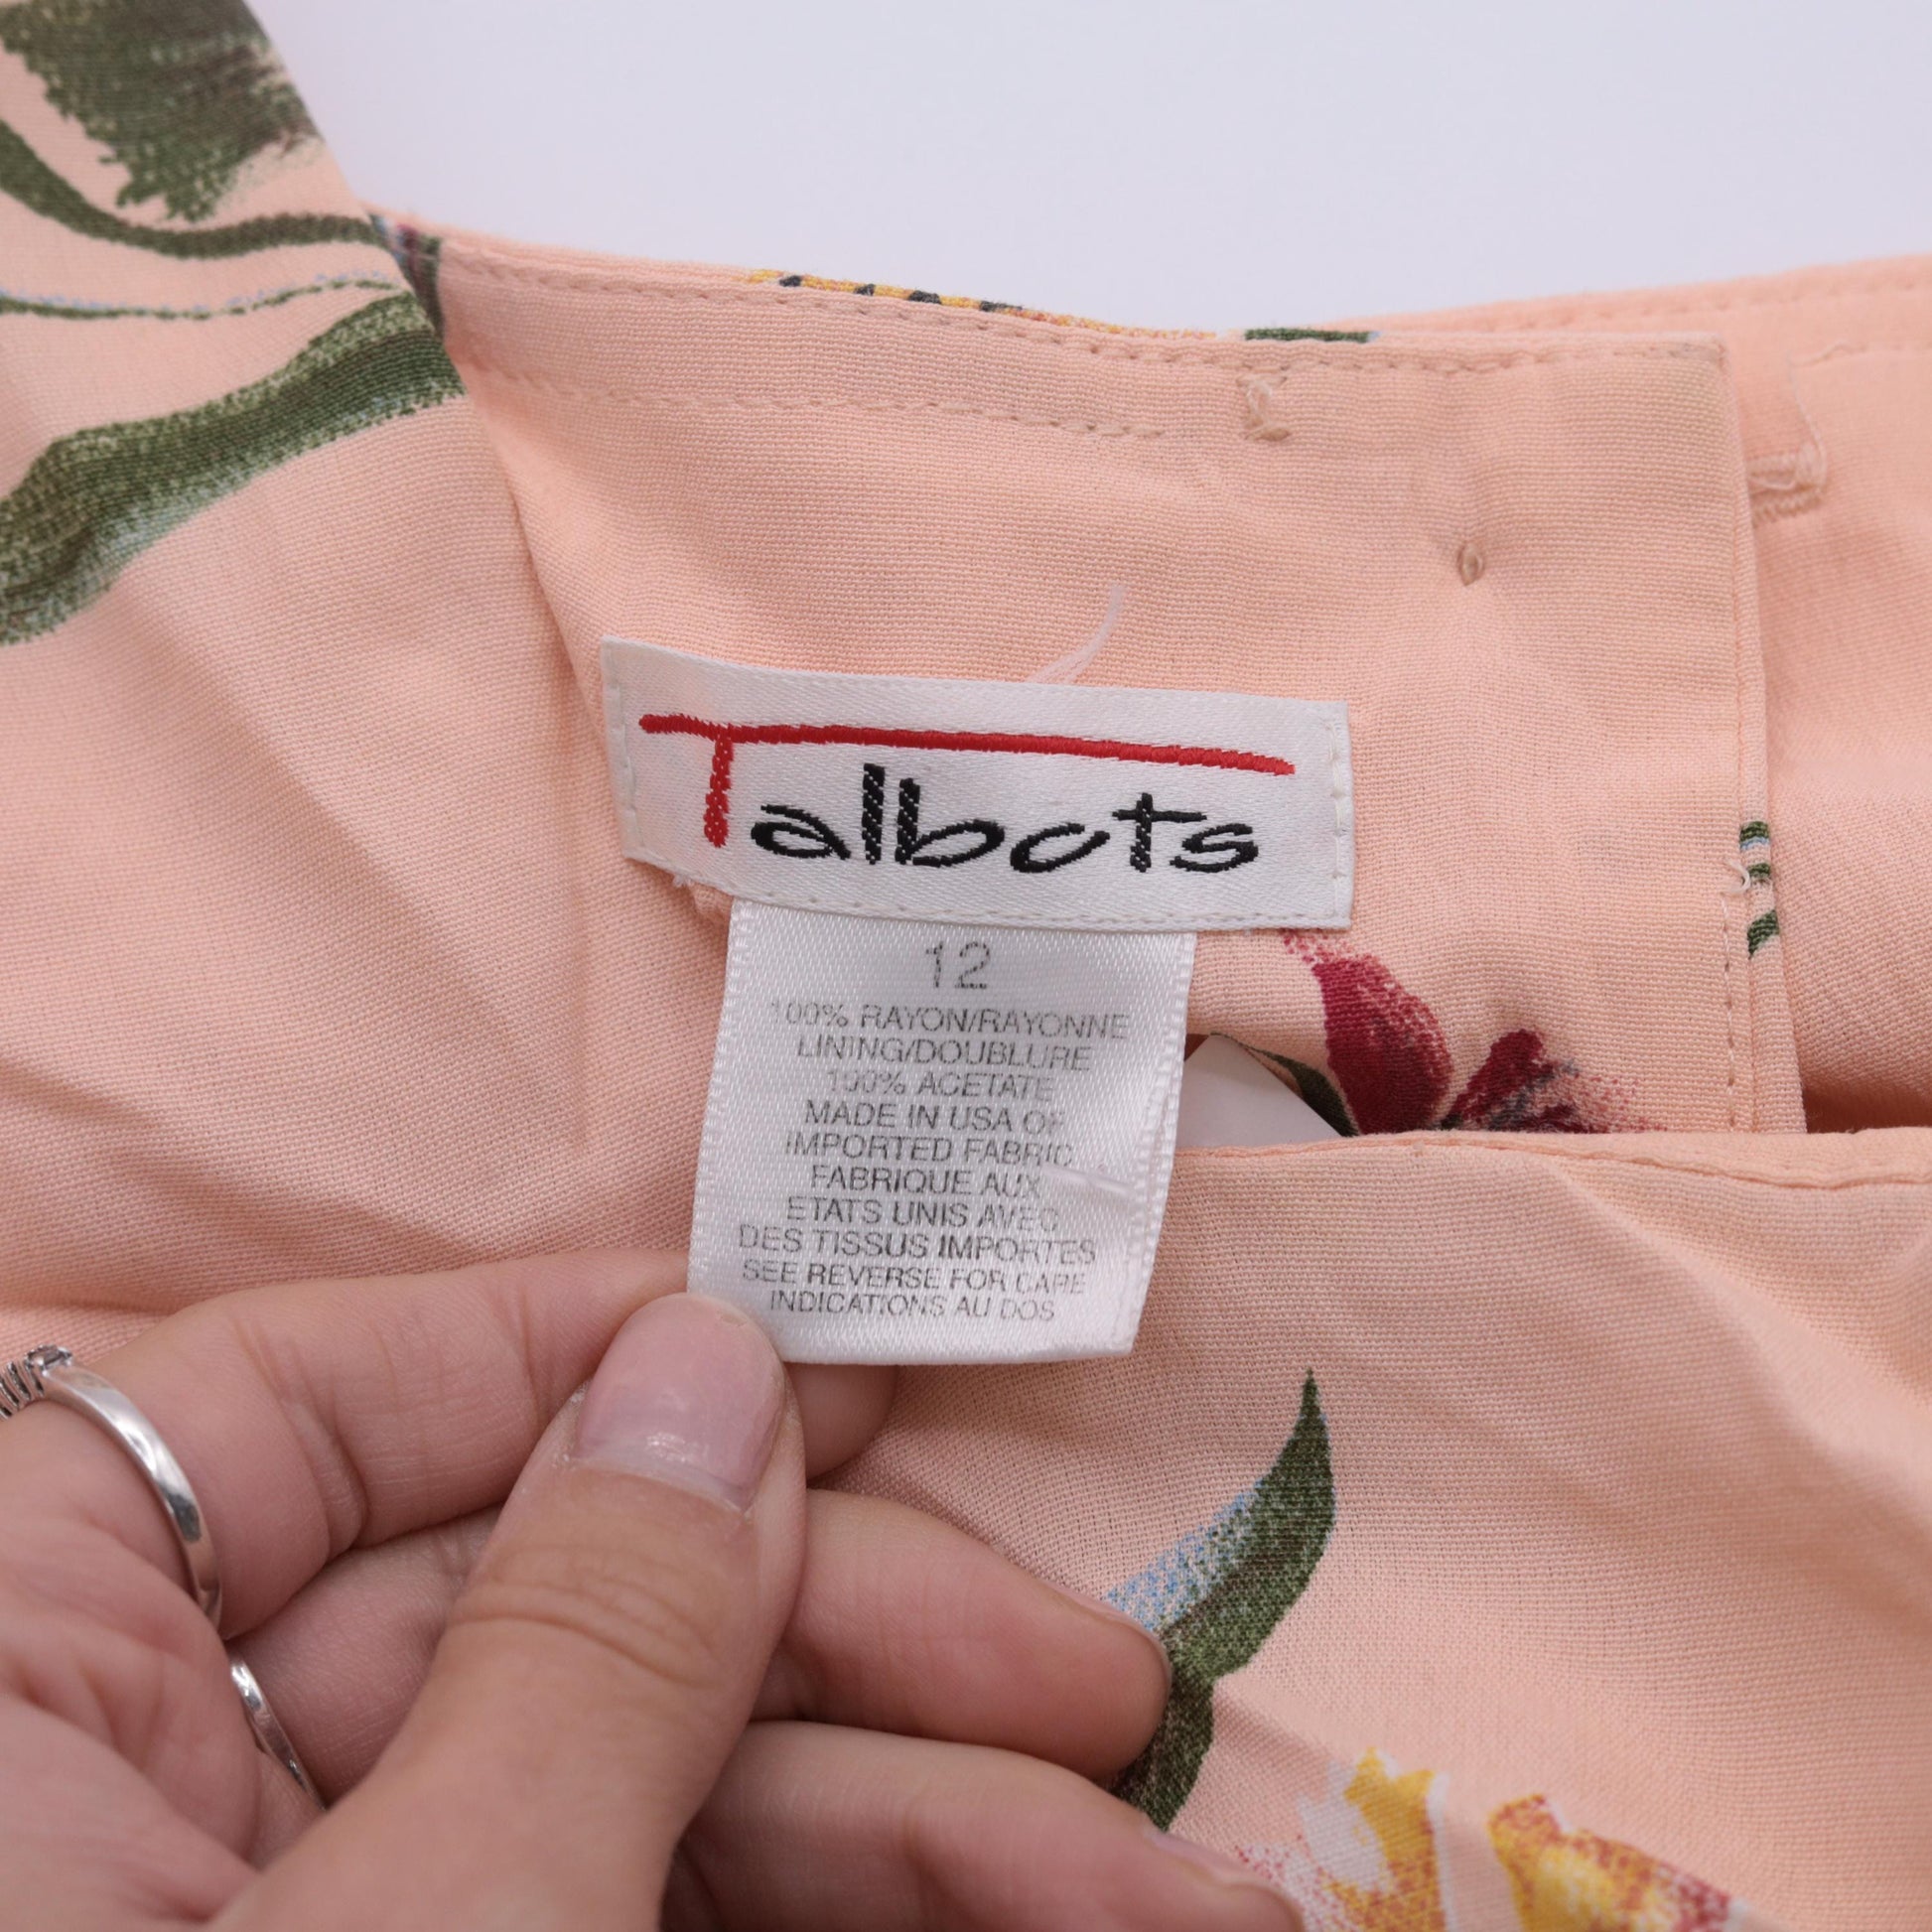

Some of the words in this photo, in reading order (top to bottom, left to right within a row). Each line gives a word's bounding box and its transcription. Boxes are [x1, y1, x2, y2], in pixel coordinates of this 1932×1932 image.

[638, 713, 1296, 873] Talbots
[924, 940, 991, 991] 12
[771, 1001, 848, 1026] 100%
[860, 1004, 1130, 1039] RAYON/RAYONNE
[796, 1035, 1092, 1071] LINING/DOUBLURE
[828, 1068, 906, 1095] 100%
[918, 1071, 1052, 1101] ACETATE
[805, 1100, 896, 1127] MADE
[908, 1104, 941, 1128] IN
[950, 1106, 1013, 1132] USA
[786, 1133, 952, 1162] IMPORTED
[964, 1138, 1072, 1166] FABRIC
[811, 1165, 971, 1195] FABRIQUE
[983, 1170, 1042, 1196] AUX
[787, 1196, 882, 1223] ETATS
[893, 1200, 967, 1227] UNIS
[978, 1202, 1058, 1232] AVEC
[739, 1224, 801, 1253] DES
[813, 1229, 929, 1257] TISSUS
[938, 1234, 1096, 1264] IMPORTES
[743, 1260, 799, 1283] SEE
[807, 1264, 940, 1290] REVERSE
[949, 1267, 1009, 1291] FOR
[1016, 1269, 1085, 1294] CARE
[770, 1290, 946, 1317] INDICATIONS
[955, 1295, 989, 1317] AU
[1000, 1298, 1054, 1320] DOS
